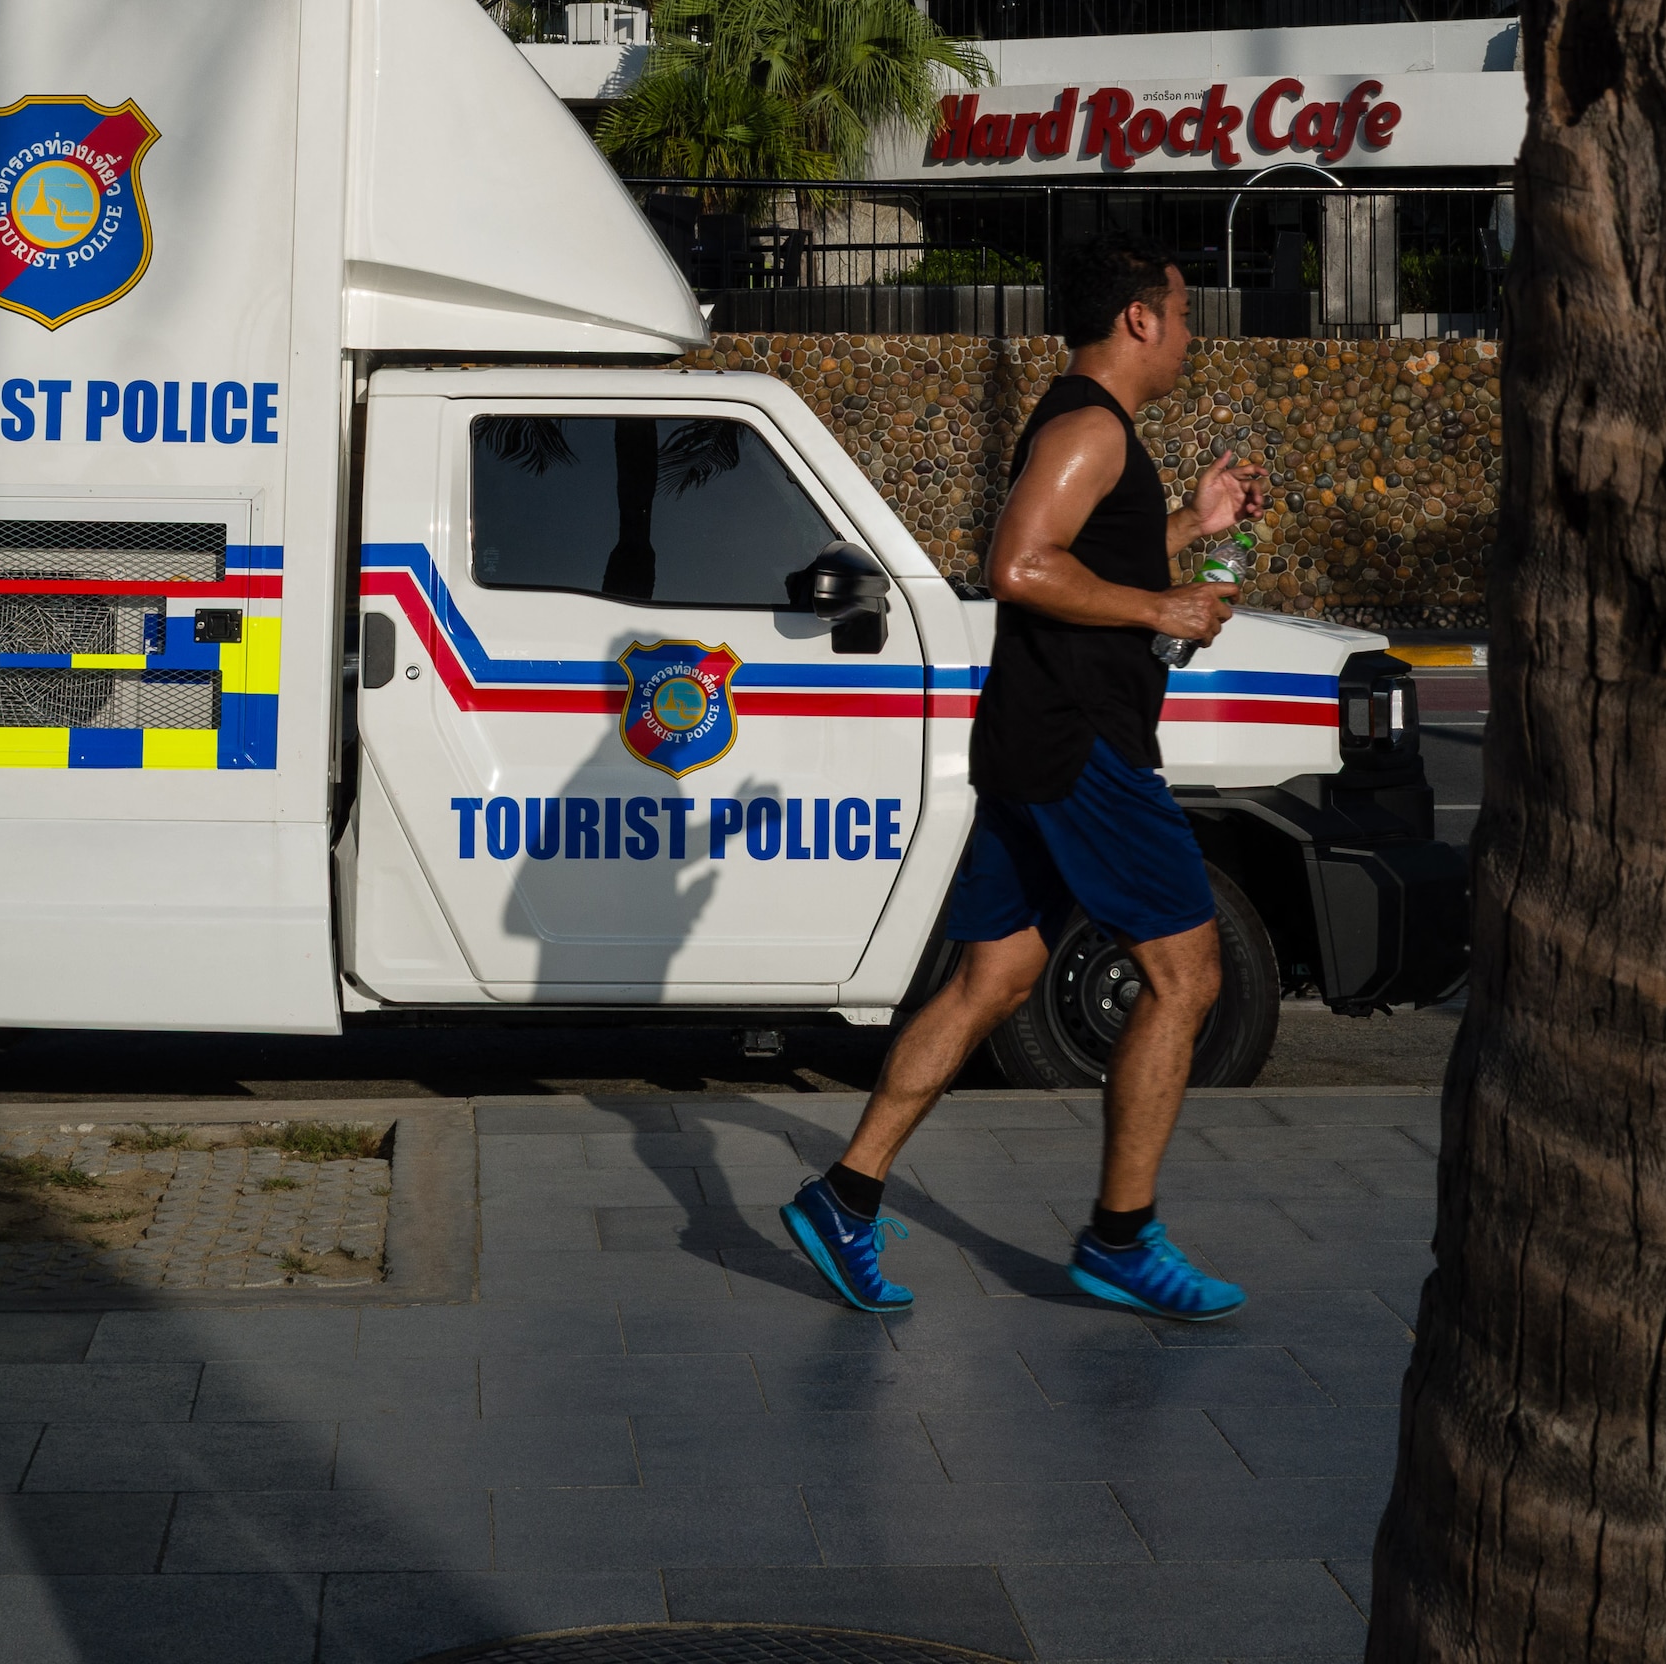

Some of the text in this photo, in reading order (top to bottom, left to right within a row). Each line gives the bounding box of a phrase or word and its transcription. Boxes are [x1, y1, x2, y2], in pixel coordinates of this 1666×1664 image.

[930, 77, 1403, 168] Hard Rock Cafe
[66, 205, 123, 268] POLICE
[86, 380, 279, 444] POLICE
[639, 661, 720, 700] ตำรวจท่องเที่ยว
[641, 702, 720, 743] TOURIST POLICE
[451, 796, 902, 861] TOURIST POLICE
